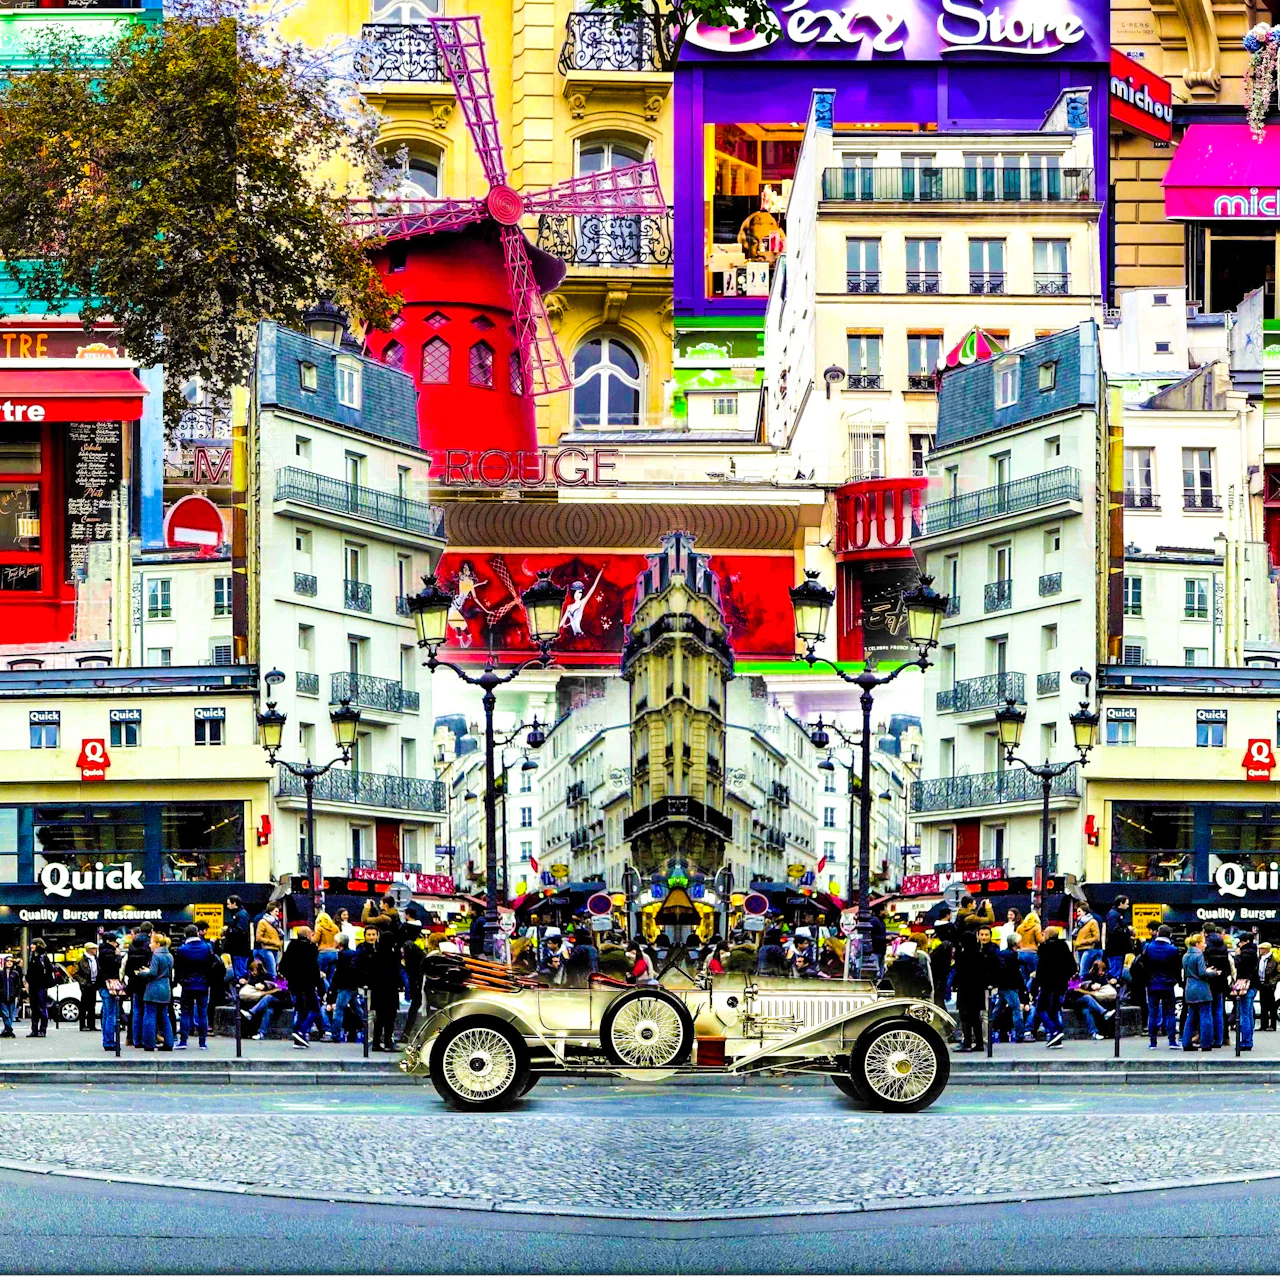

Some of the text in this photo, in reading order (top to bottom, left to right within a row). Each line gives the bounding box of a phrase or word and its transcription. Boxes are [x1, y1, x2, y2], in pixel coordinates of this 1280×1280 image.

[1111, 76, 1173, 123] michou
[444, 448, 619, 487] ROUGE
[30, 711, 60, 722] Quick
[110, 710, 140, 721] Quick
[194, 708, 225, 719] Quick
[1107, 708, 1136, 719] Quick
[1197, 710, 1227, 721] Quick
[84, 741, 105, 762] Q
[1250, 742, 1270, 762] Q
[82, 769, 104, 777] Quick
[1248, 769, 1269, 777] Quick
[41, 862, 145, 897] Quick
[19, 908, 163, 922] Quality Burger Restaurant
[1197, 908, 1235, 921] Quality
[1241, 908, 1276, 920] Burger
